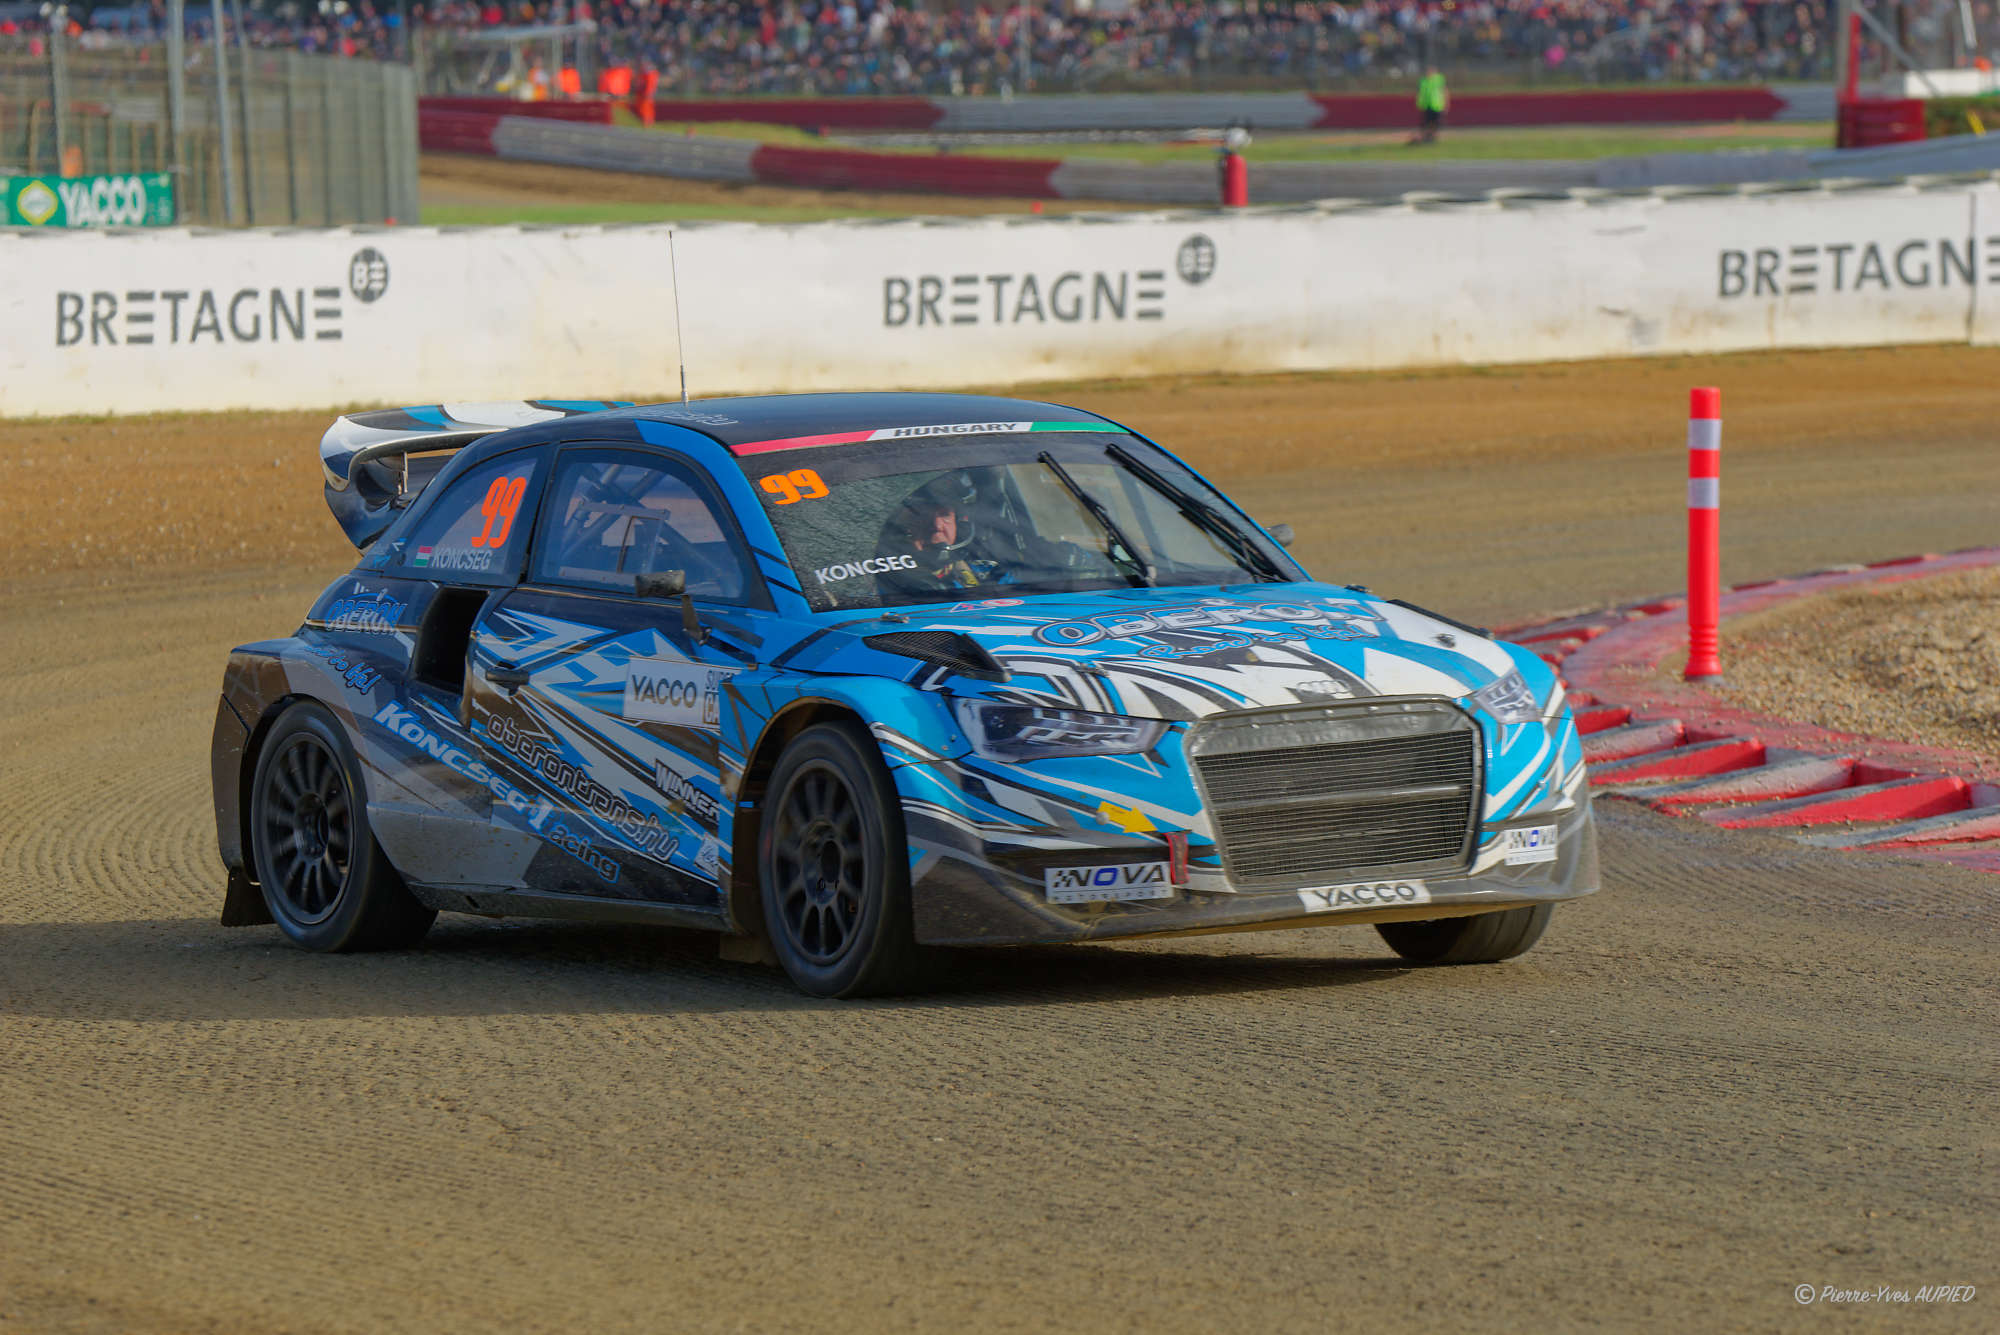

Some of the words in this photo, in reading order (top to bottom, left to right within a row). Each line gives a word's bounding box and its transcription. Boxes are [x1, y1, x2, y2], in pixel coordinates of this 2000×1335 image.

[58, 176, 147, 227] YACCO
[55, 287, 342, 346] BRETAGNE
[883, 271, 1165, 327] BRETAGNE
[894, 423, 1017, 437] HUNGARY
[759, 468, 830, 505] 99
[471, 476, 527, 549] 99
[431, 546, 493, 571] KONCSEG
[814, 554, 918, 585] KONCSEG
[1033, 602, 1386, 647] OBERON
[632, 674, 698, 709] YACCO
[1055, 864, 1166, 888] NOVA
[1312, 881, 1417, 907] YACCO
